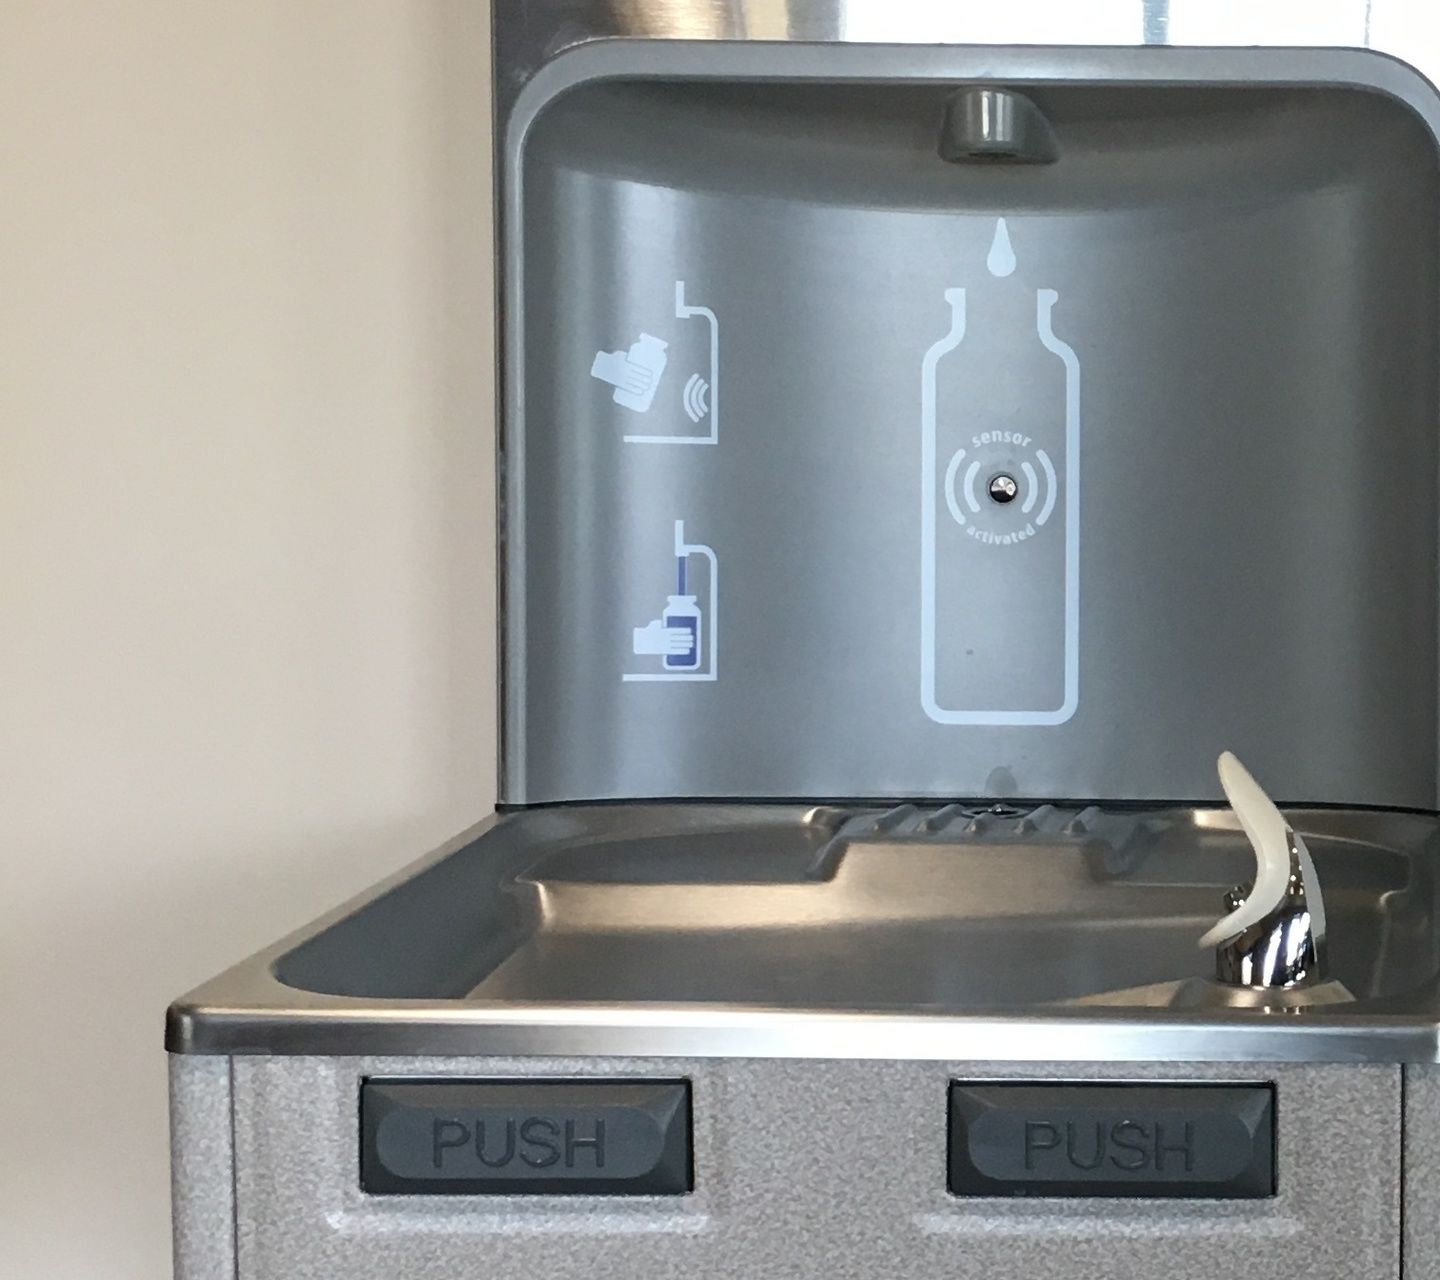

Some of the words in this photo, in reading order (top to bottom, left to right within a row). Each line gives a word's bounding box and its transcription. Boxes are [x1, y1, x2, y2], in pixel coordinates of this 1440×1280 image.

[971, 430, 1032, 448] sensor
[966, 523, 1036, 545] activated
[433, 1118, 606, 1168] PUSH
[1024, 1120, 1194, 1171] PUSH
